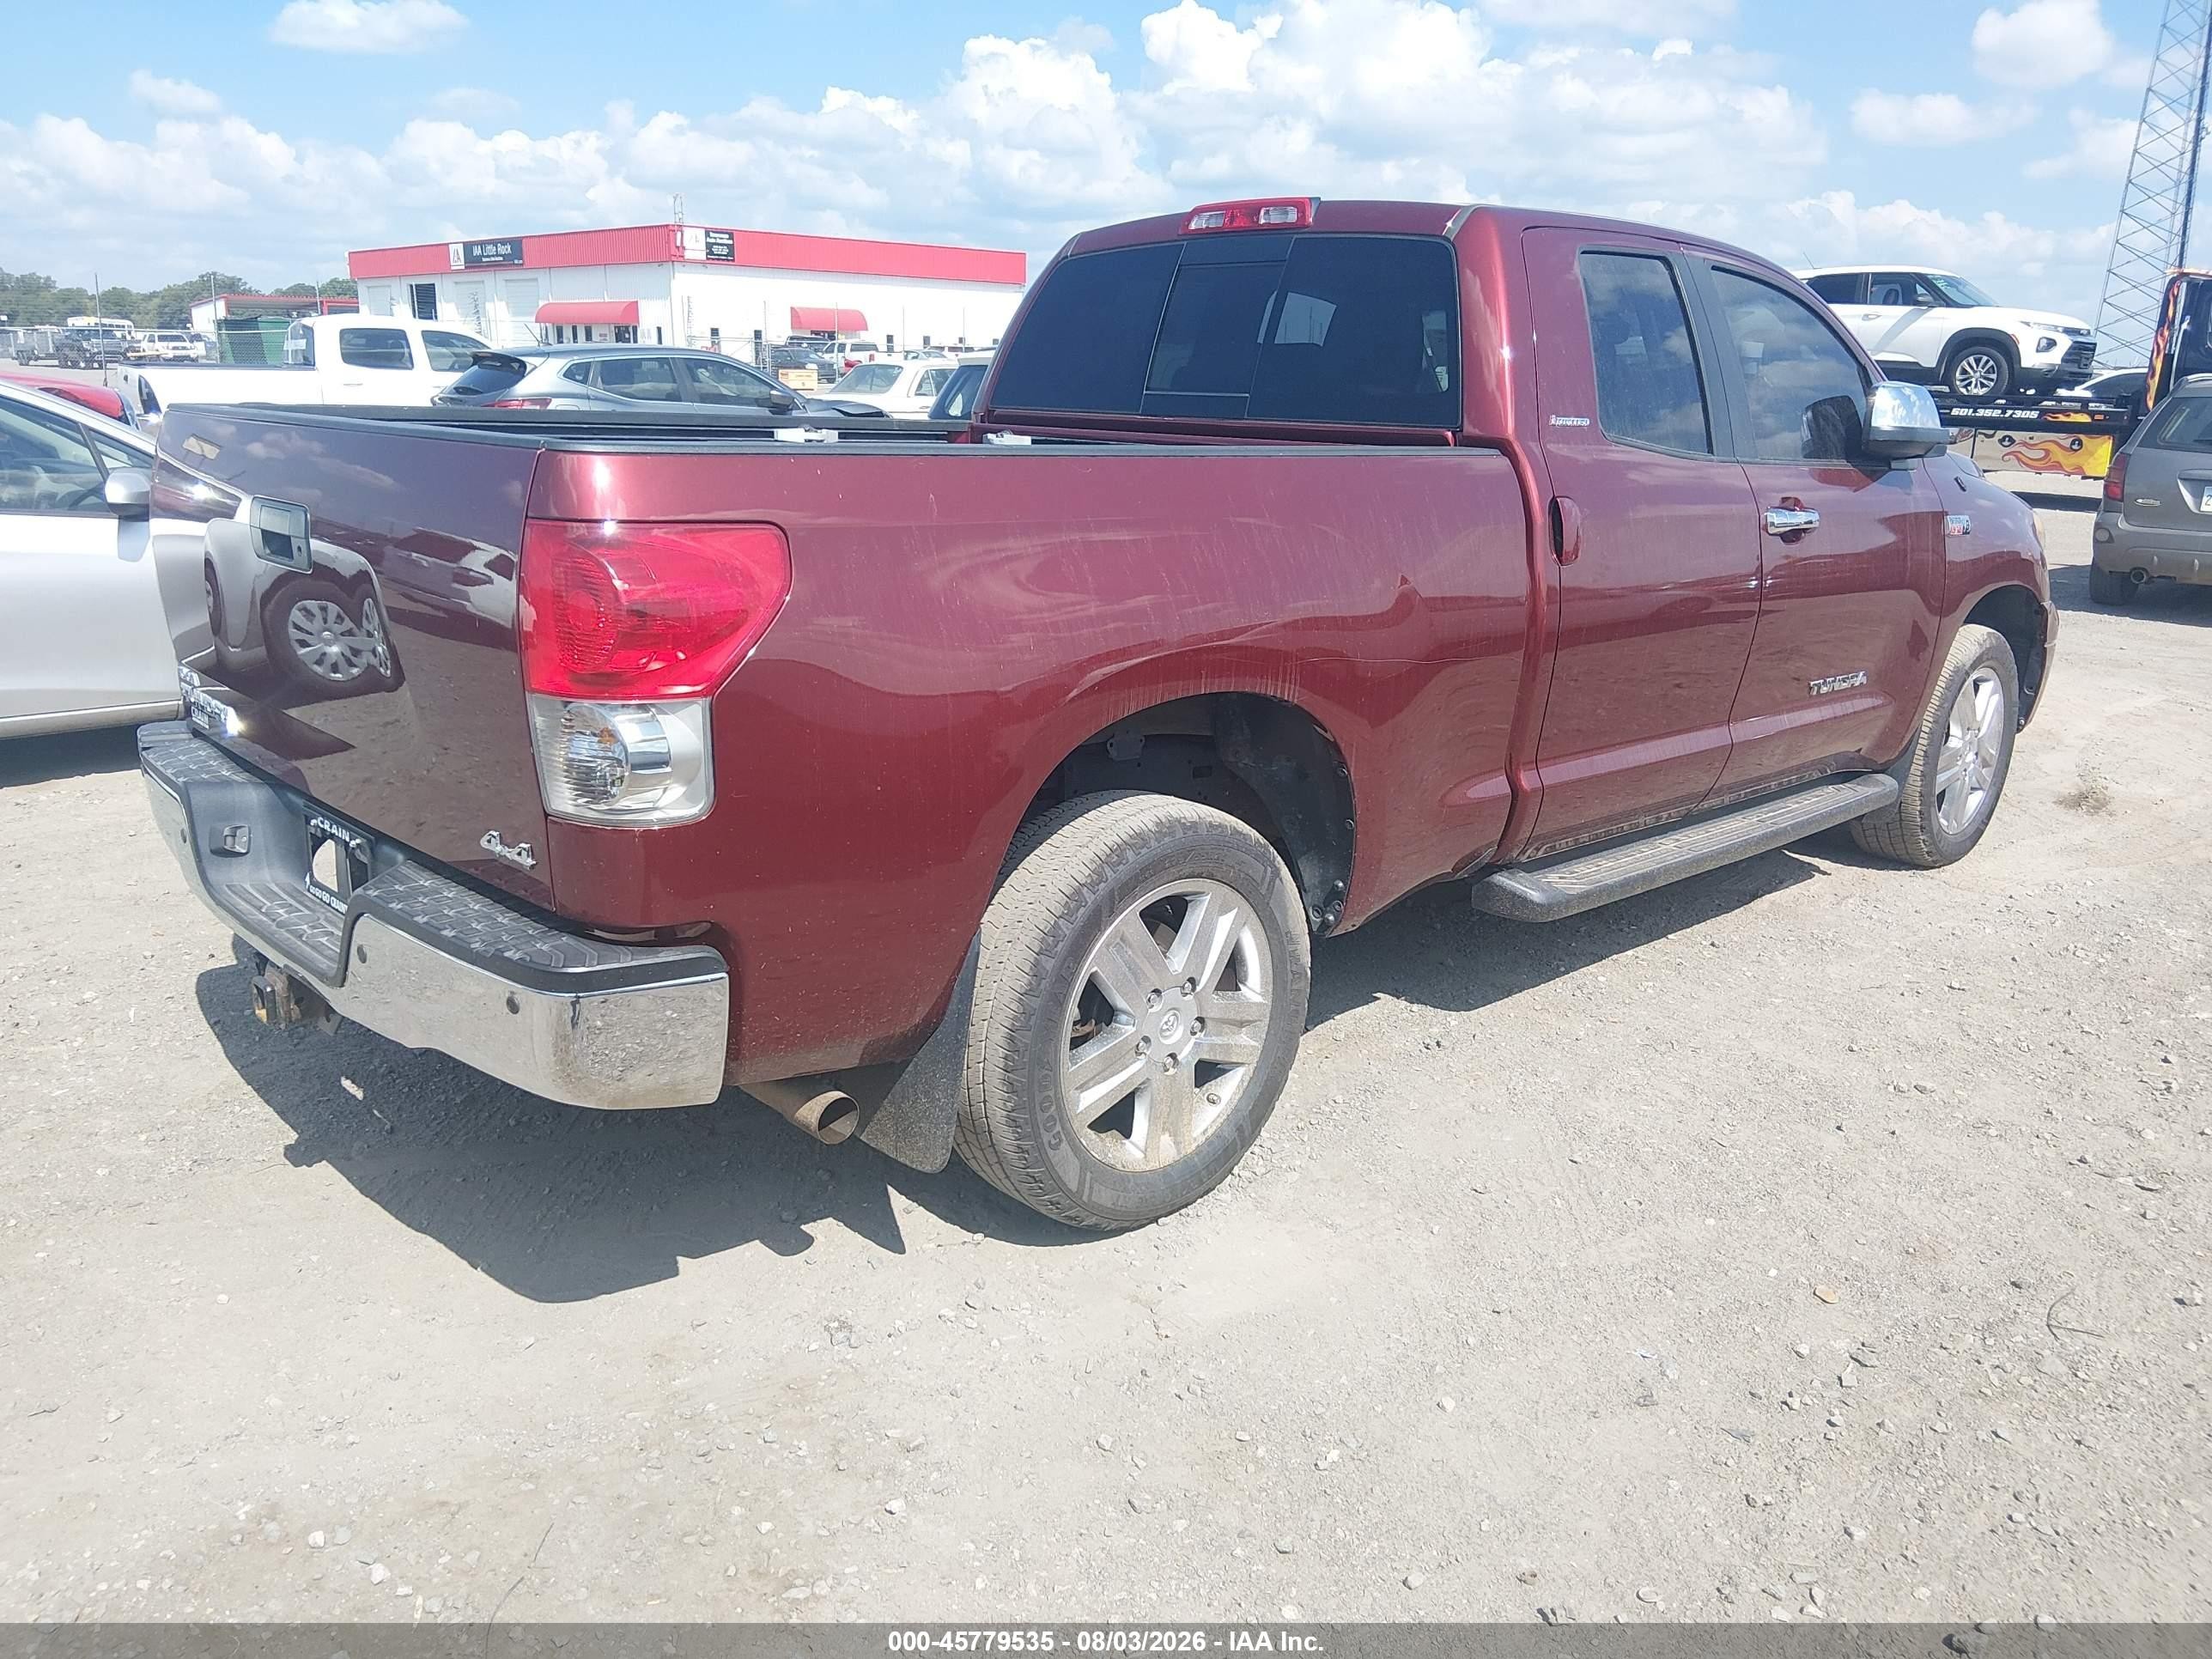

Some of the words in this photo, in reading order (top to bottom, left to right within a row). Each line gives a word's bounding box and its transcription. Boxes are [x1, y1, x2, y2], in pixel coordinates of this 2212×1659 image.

[472, 245, 483, 256] IAA
[483, 244, 497, 256] Little
[497, 242, 513, 255] Rock
[1950, 407, 2040, 419] 601.352.7305
[1809, 671, 1867, 696] TUNDRA
[317, 817, 350, 842] CRAIN
